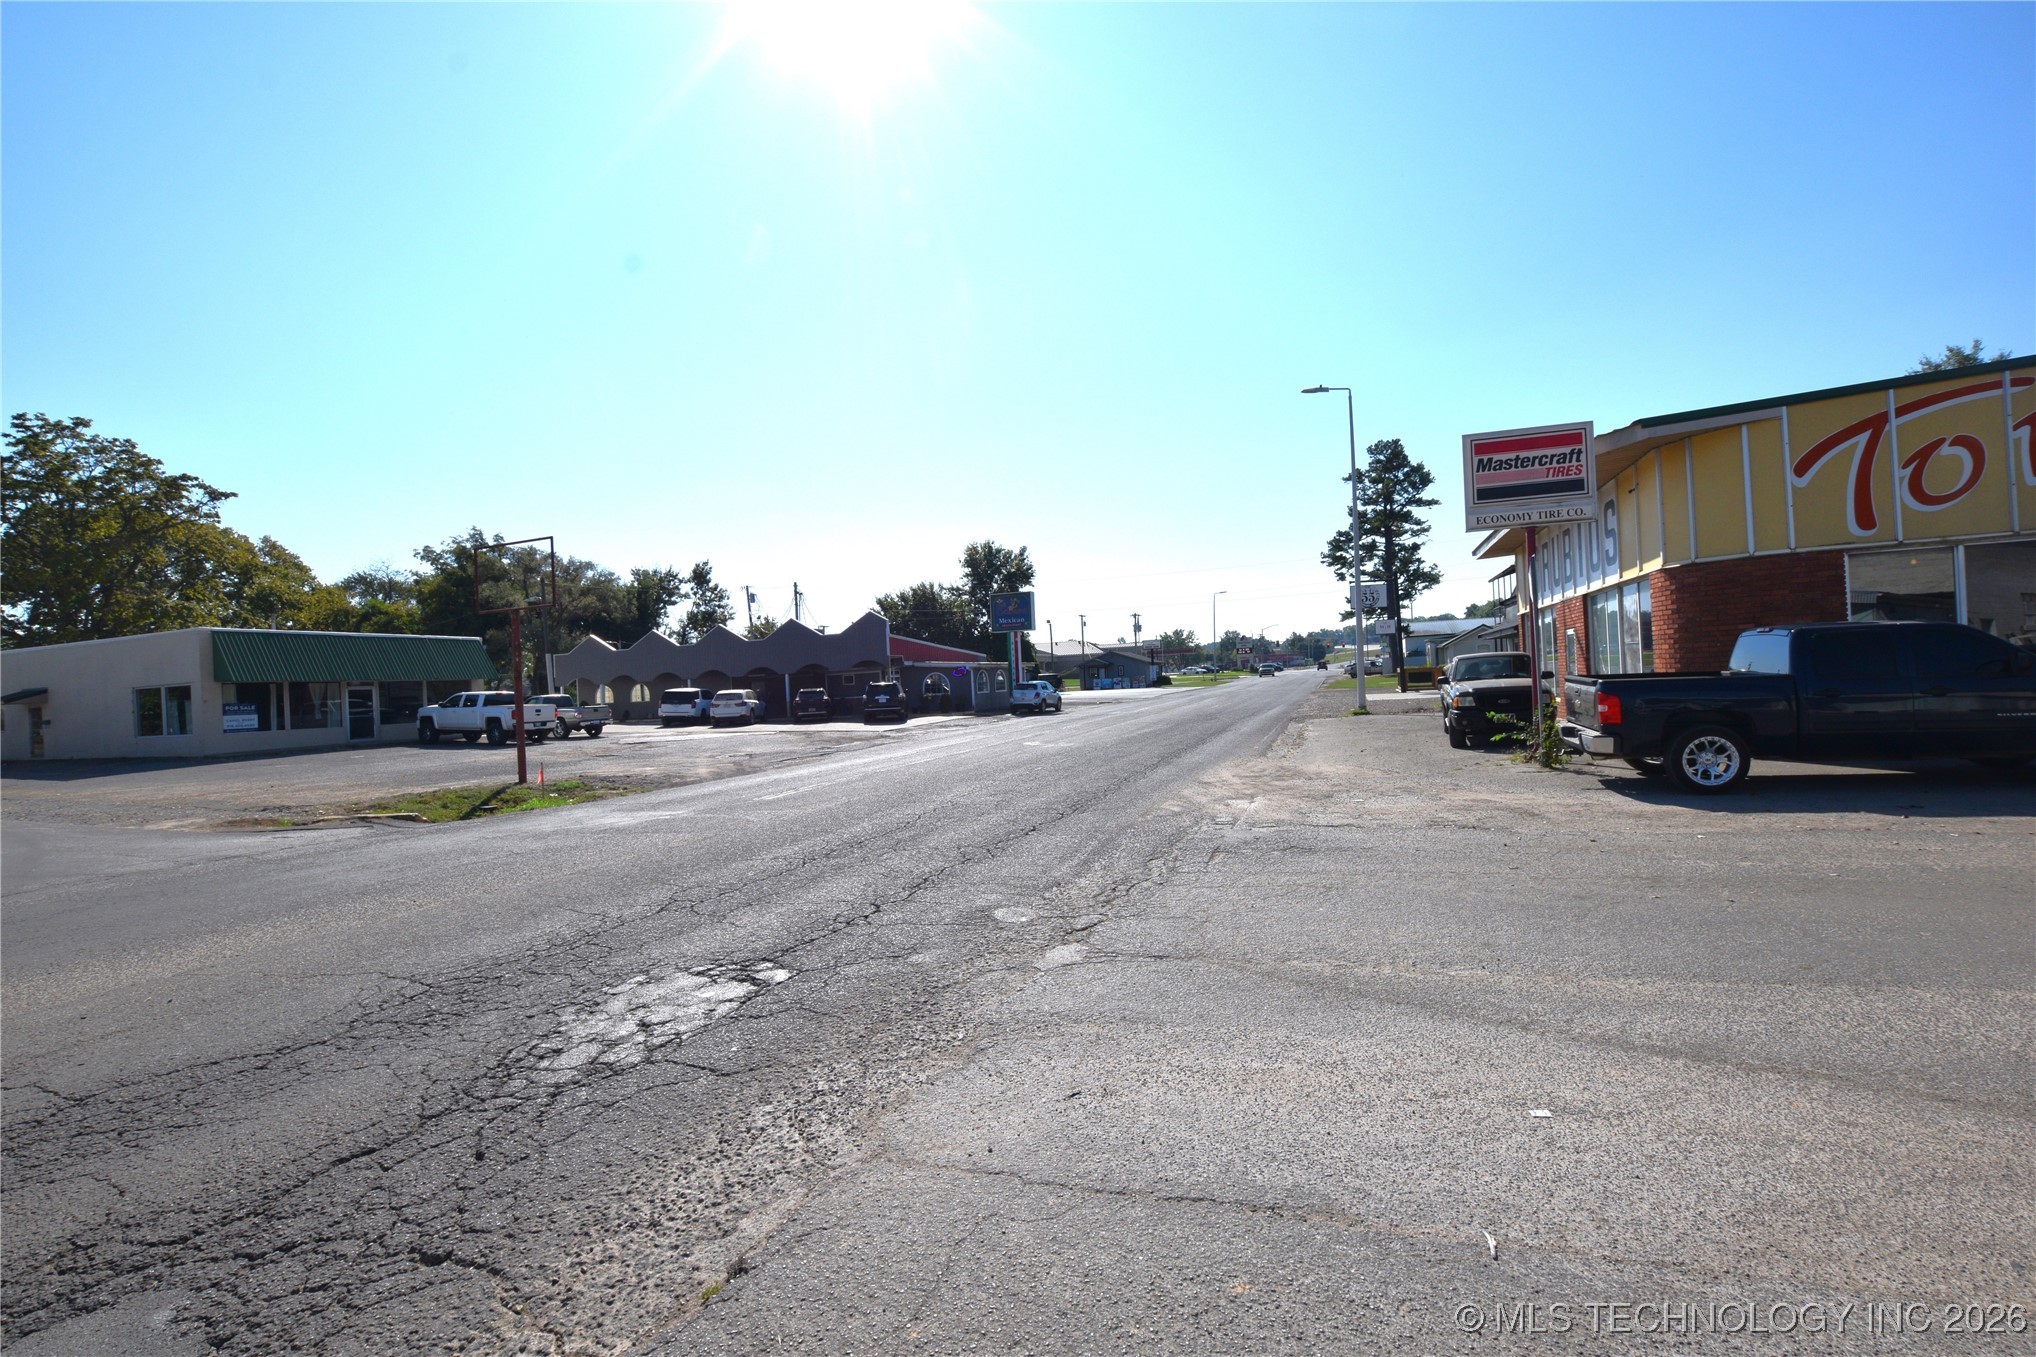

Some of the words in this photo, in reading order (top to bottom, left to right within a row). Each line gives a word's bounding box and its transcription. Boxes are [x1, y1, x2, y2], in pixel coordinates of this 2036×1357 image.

[1476, 448, 1583, 473] Mastercraft
[1792, 377, 2036, 536] To
[1545, 464, 1583, 478] TIRES
[1476, 512, 1534, 525] ECONOMY
[1536, 509, 1564, 520] TIRE
[1567, 507, 1587, 517] CO.
